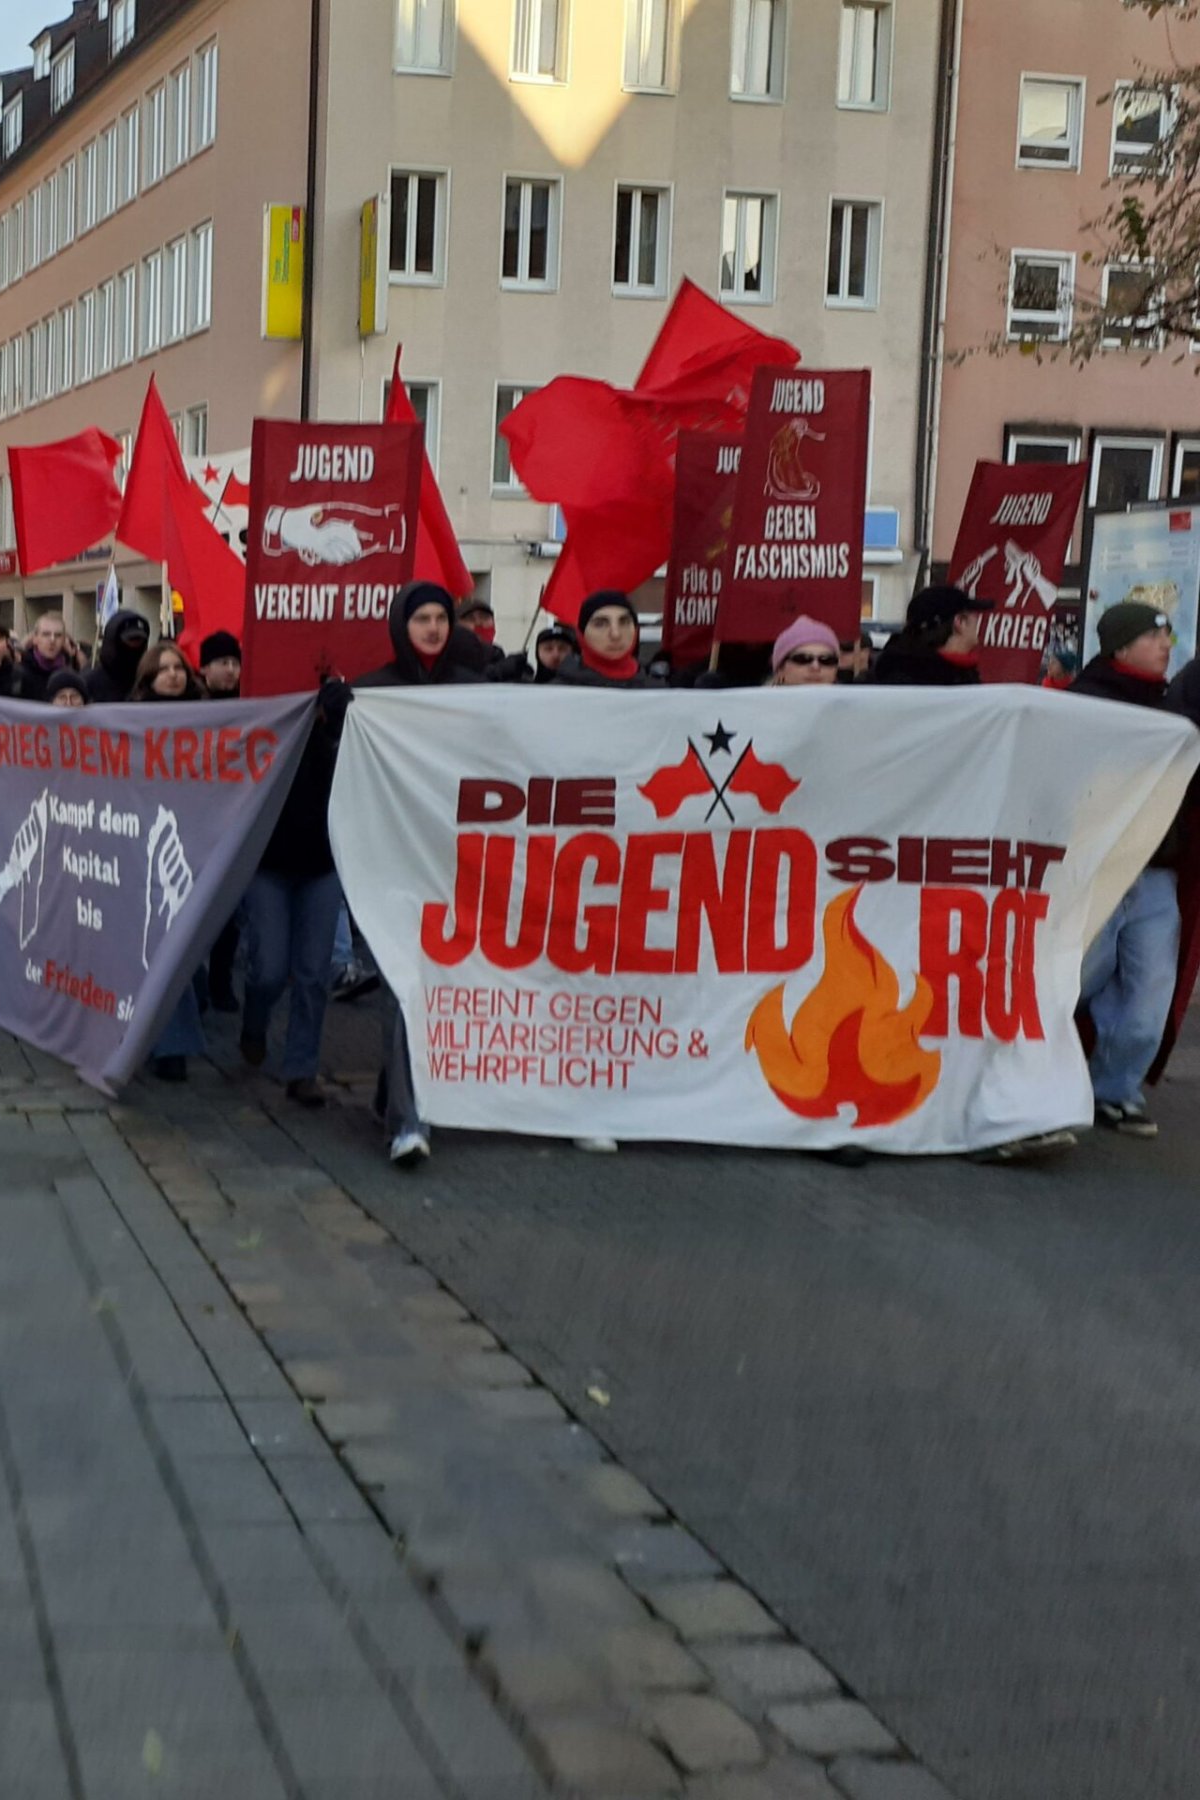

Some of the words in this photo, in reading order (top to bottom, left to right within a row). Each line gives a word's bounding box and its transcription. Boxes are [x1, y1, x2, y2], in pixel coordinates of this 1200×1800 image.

[770, 378, 825, 413] JUGEND
[290, 444, 374, 482] JUGEND
[764, 505, 816, 540] GEGEN
[990, 492, 1053, 526] JUGEND
[683, 562, 708, 595] FÜR
[734, 543, 850, 580] FASCHISMUS
[254, 583, 339, 621] VEREINT
[983, 612, 1048, 651] KRIEG
[58, 724, 131, 780] DEM
[143, 726, 279, 784] KRIEG
[49, 795, 95, 835] Kampf
[99, 801, 140, 838] dem
[456, 776, 617, 828] DIE
[62, 845, 120, 887] Kapital
[824, 836, 1068, 891] SIEHT
[76, 896, 103, 931] bis
[419, 827, 818, 977] JUGEND
[917, 887, 1051, 1044] ROT
[44, 959, 117, 1018] Frieden
[424, 984, 540, 1019] VEREINT
[549, 990, 663, 1027] GEGEN
[426, 1017, 680, 1060] MILITARISIERUNG
[687, 1028, 710, 1060] &
[426, 1051, 636, 1091] WEHRPFLICHT
